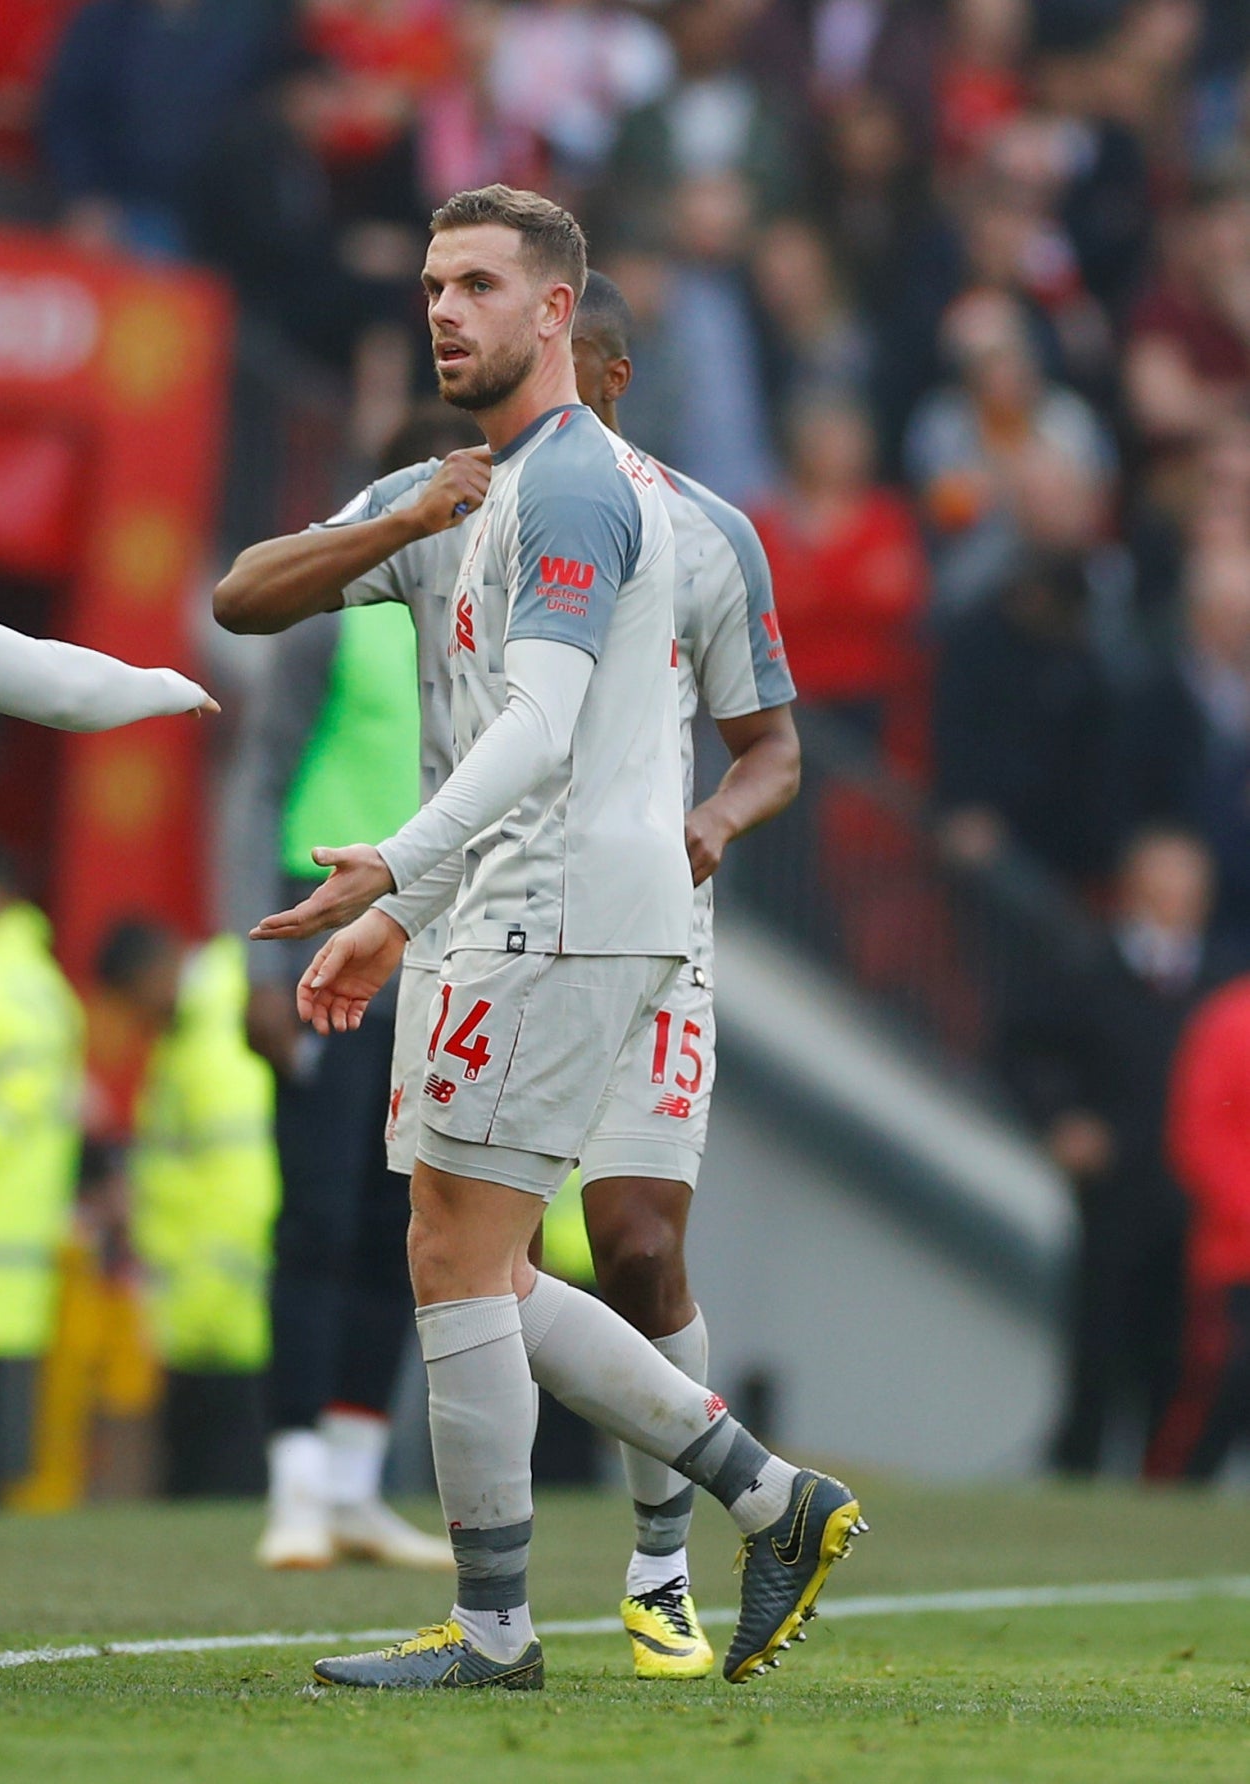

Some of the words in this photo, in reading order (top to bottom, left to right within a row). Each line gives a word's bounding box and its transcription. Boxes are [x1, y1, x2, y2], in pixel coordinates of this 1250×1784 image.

[535, 585, 589, 605] Western
[546, 599, 587, 617] Union
[426, 982, 492, 1082] 14
[651, 1009, 703, 1095] 15
